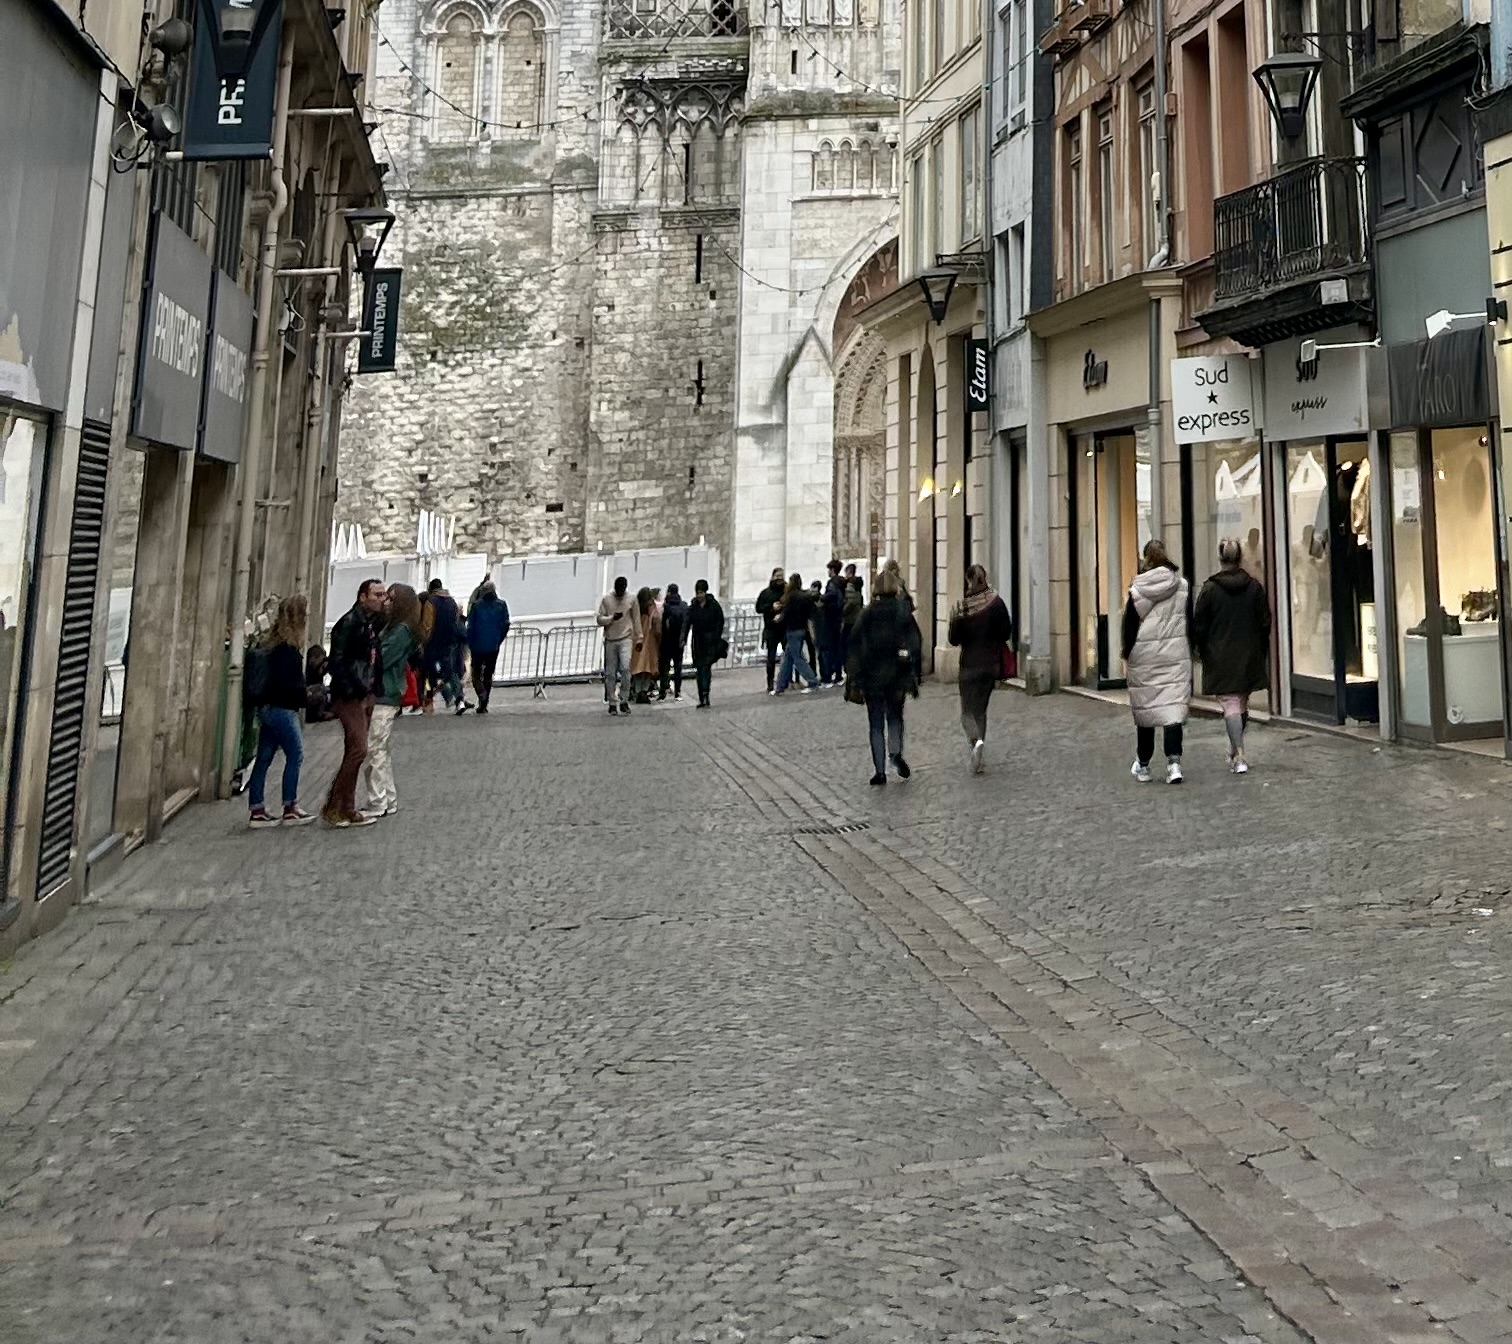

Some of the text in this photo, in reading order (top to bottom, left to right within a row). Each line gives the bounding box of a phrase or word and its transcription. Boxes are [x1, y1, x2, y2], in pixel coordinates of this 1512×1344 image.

[372, 282, 389, 358] PRINTEMPS
[969, 347, 987, 403] Etam
[1194, 361, 1229, 386] Sud
[1177, 409, 1251, 436] express
